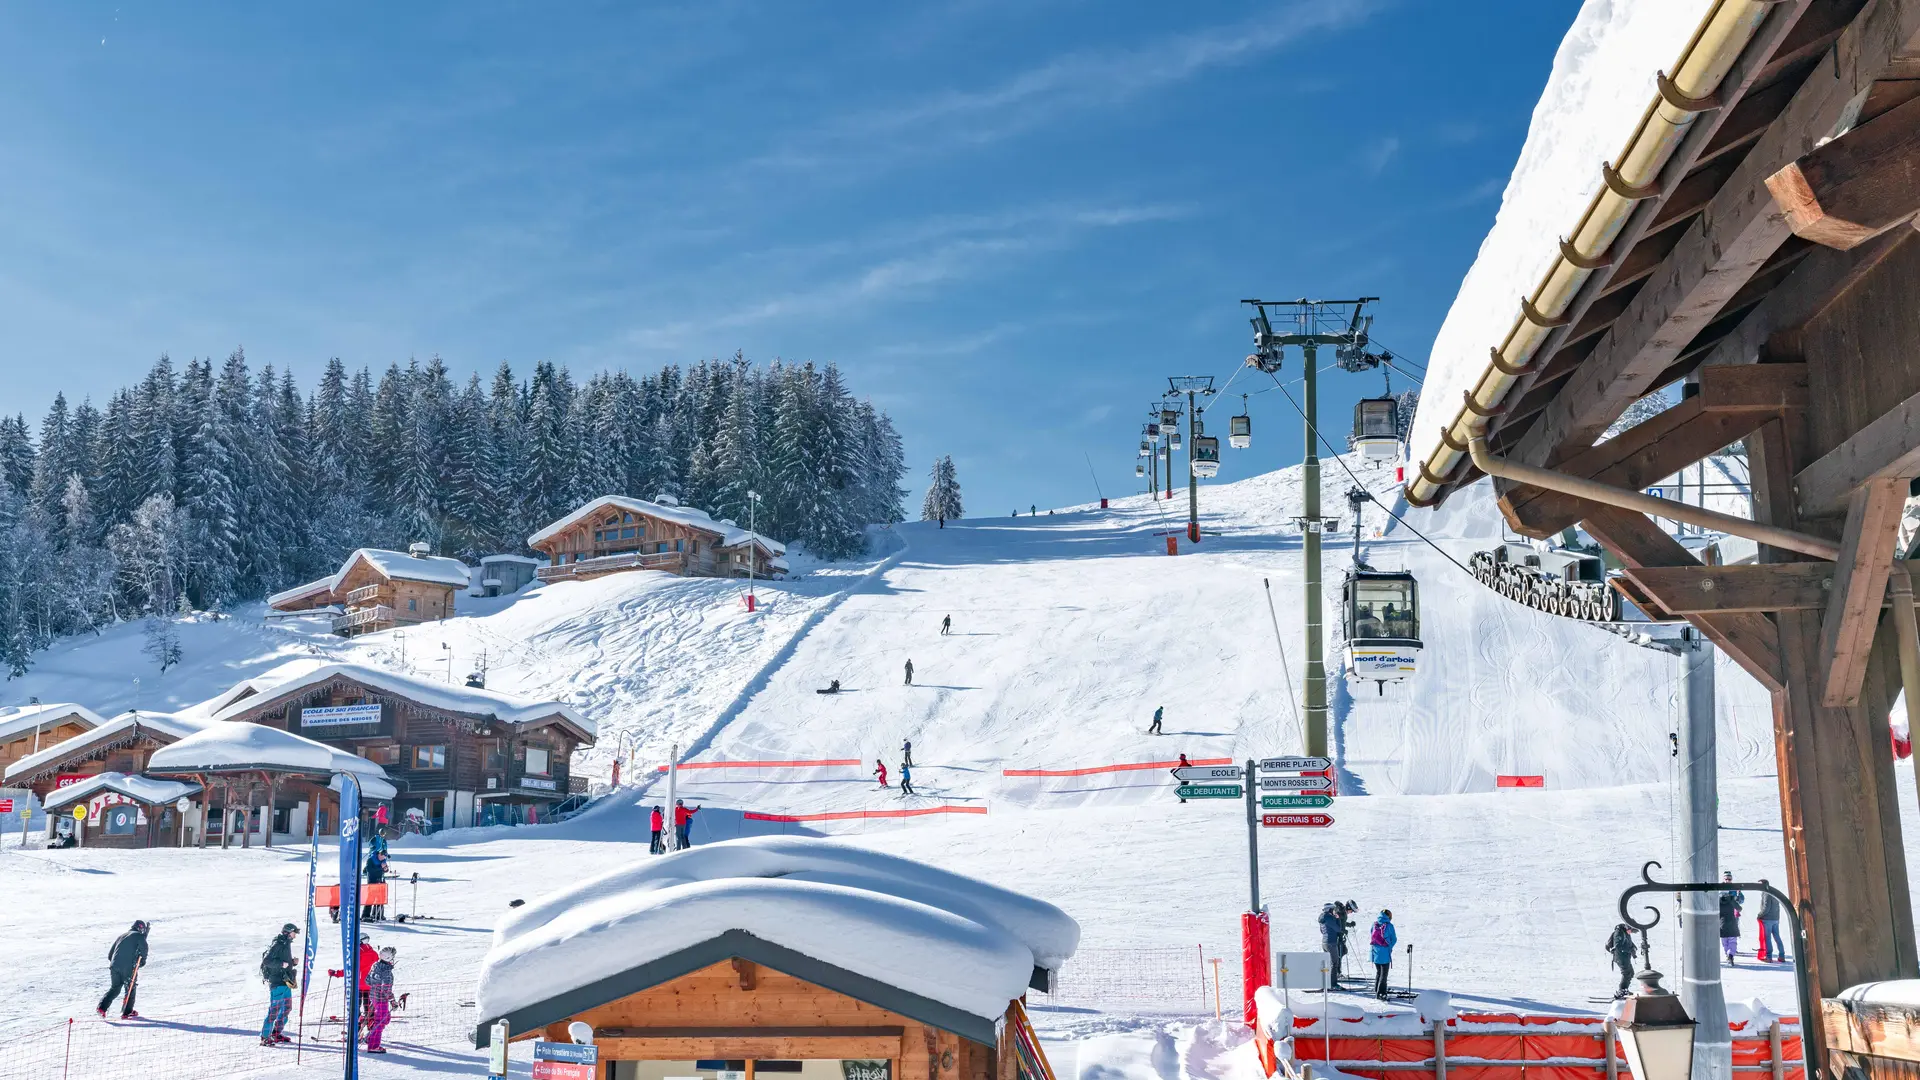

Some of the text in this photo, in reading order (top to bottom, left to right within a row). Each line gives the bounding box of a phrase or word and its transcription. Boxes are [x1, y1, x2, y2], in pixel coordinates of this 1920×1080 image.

[1378, 655, 1415, 663] d'arbois
[1264, 760, 1317, 769] PIERRE PLATE
[1211, 769, 1236, 777] ECOLE
[1287, 779, 1317, 787] ROSSETS
[1179, 787, 1236, 795] 155 DEBUTANTE
[1283, 797, 1313, 805] BLANCHE
[1314, 797, 1325, 805] 155
[1265, 816, 1325, 824] ST GERVAIS 150
[541, 1046, 552, 1055] Piste
[551, 1067, 557, 1075] du
[556, 1067, 564, 1076] Ski
